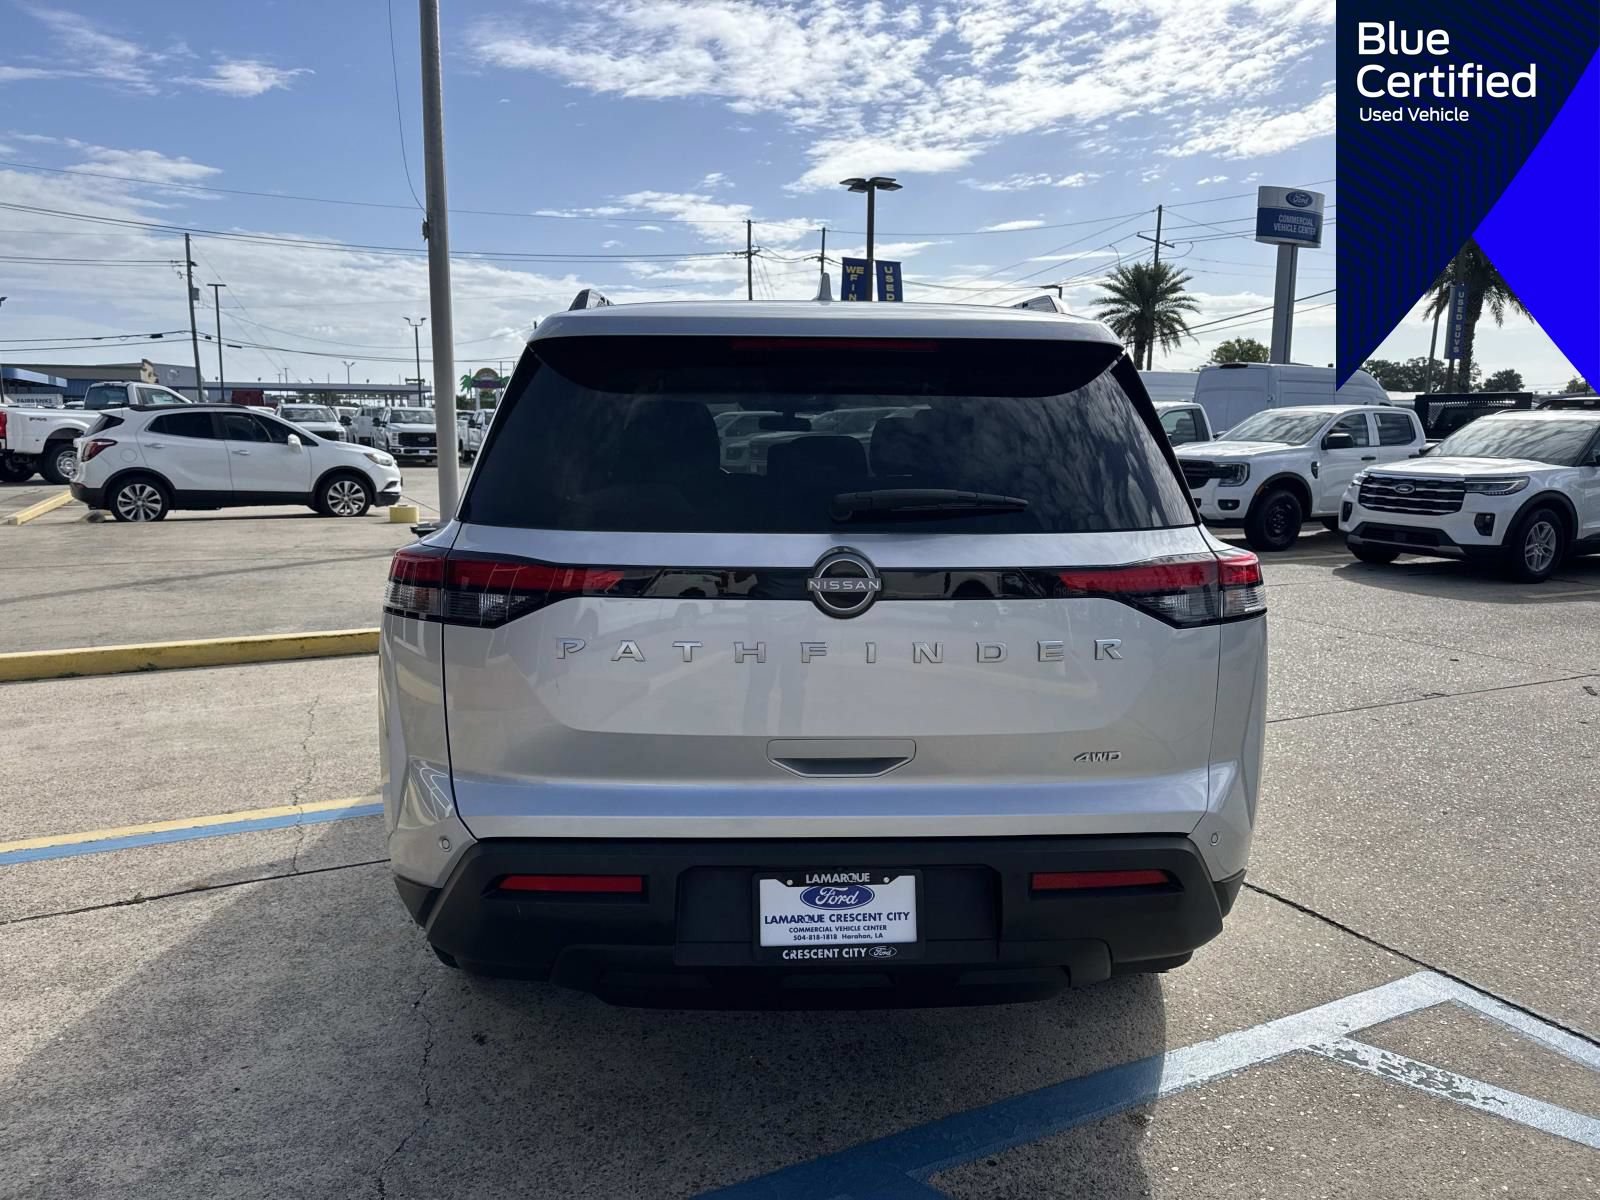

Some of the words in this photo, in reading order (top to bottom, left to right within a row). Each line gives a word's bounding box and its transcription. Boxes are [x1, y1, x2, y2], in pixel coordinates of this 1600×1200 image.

[1278, 214, 1313, 226] COMMERCIAL
[1273, 222, 1297, 233] VEHICLE
[1297, 225, 1317, 235] CENTER
[846, 265, 865, 275] WE
[884, 265, 895, 302] USED
[1456, 291, 1465, 320] USED
[809, 580, 879, 590] NISSAN
[556, 637, 1123, 664] PATHFINDER
[805, 872, 871, 884] LAMARQUE
[815, 886, 859, 905] Ford
[764, 914, 826, 925] LAMARQUE
[828, 912, 883, 923] CRESCENT
[886, 911, 911, 921] CITY
[782, 948, 840, 960] CRESCENT
[841, 947, 868, 959] CITY
